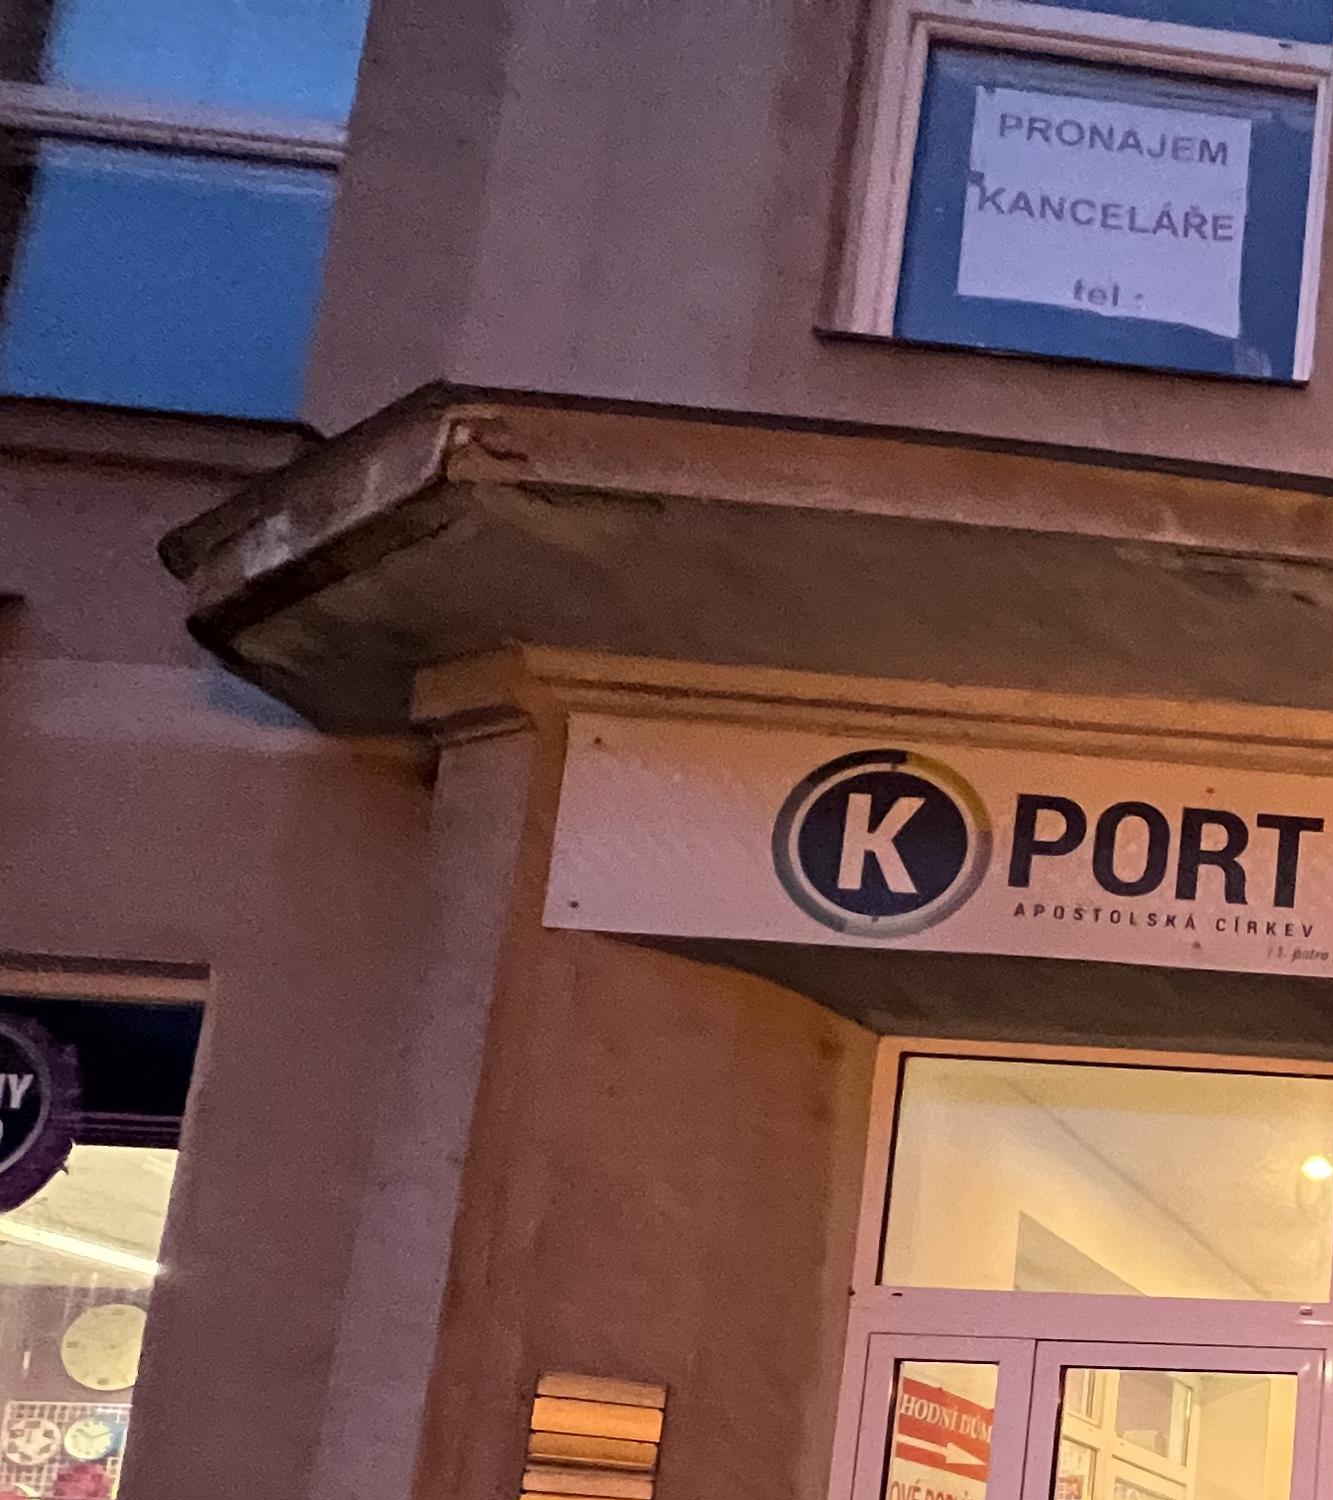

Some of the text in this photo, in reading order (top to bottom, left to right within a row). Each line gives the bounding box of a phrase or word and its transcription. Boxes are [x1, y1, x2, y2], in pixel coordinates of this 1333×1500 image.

[836, 791, 1326, 910] K PORT
[1013, 902, 1314, 938] APOSTOLSKÁ CÍRKEV
